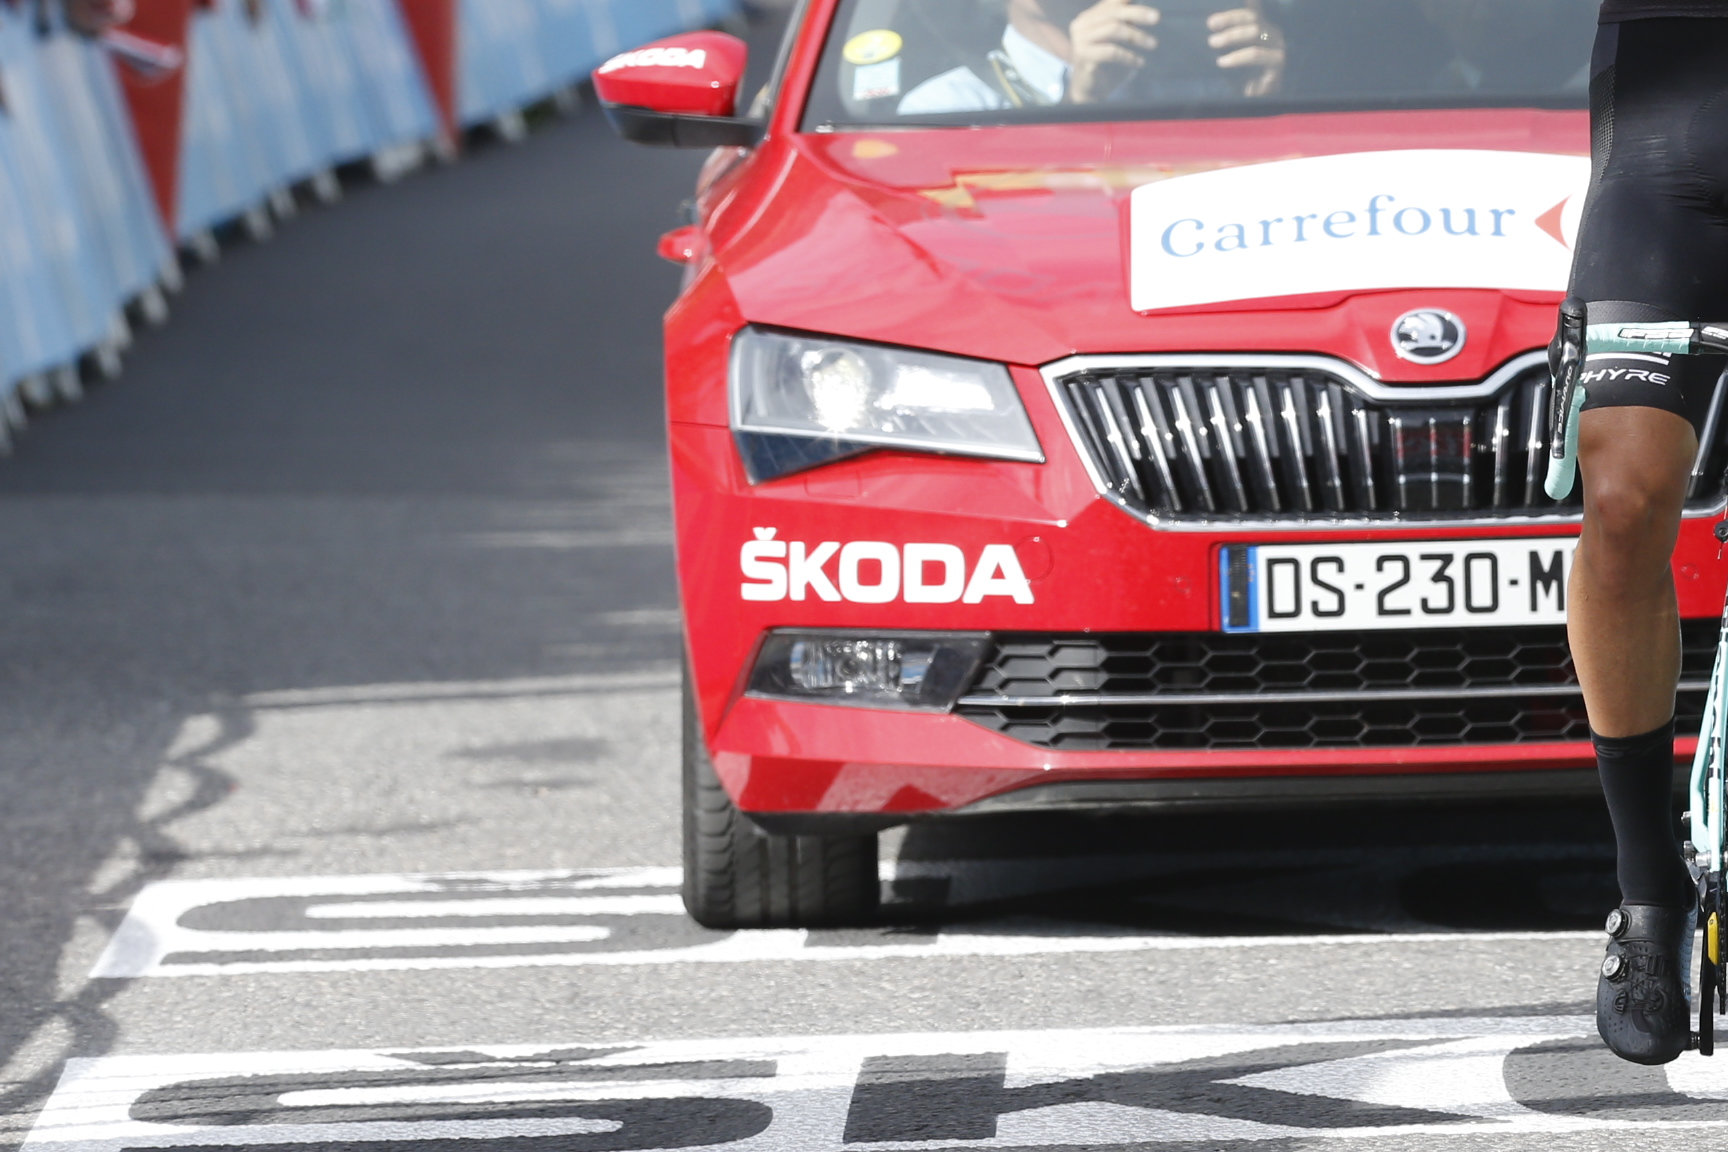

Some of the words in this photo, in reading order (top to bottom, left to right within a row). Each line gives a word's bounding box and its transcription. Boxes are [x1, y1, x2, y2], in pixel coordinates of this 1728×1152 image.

[1160, 194, 1516, 258] Carrefour
[1580, 368, 1671, 386] PHYRE
[740, 526, 1036, 605] ŠKODA
[1266, 549, 1577, 620] DS-230-M
